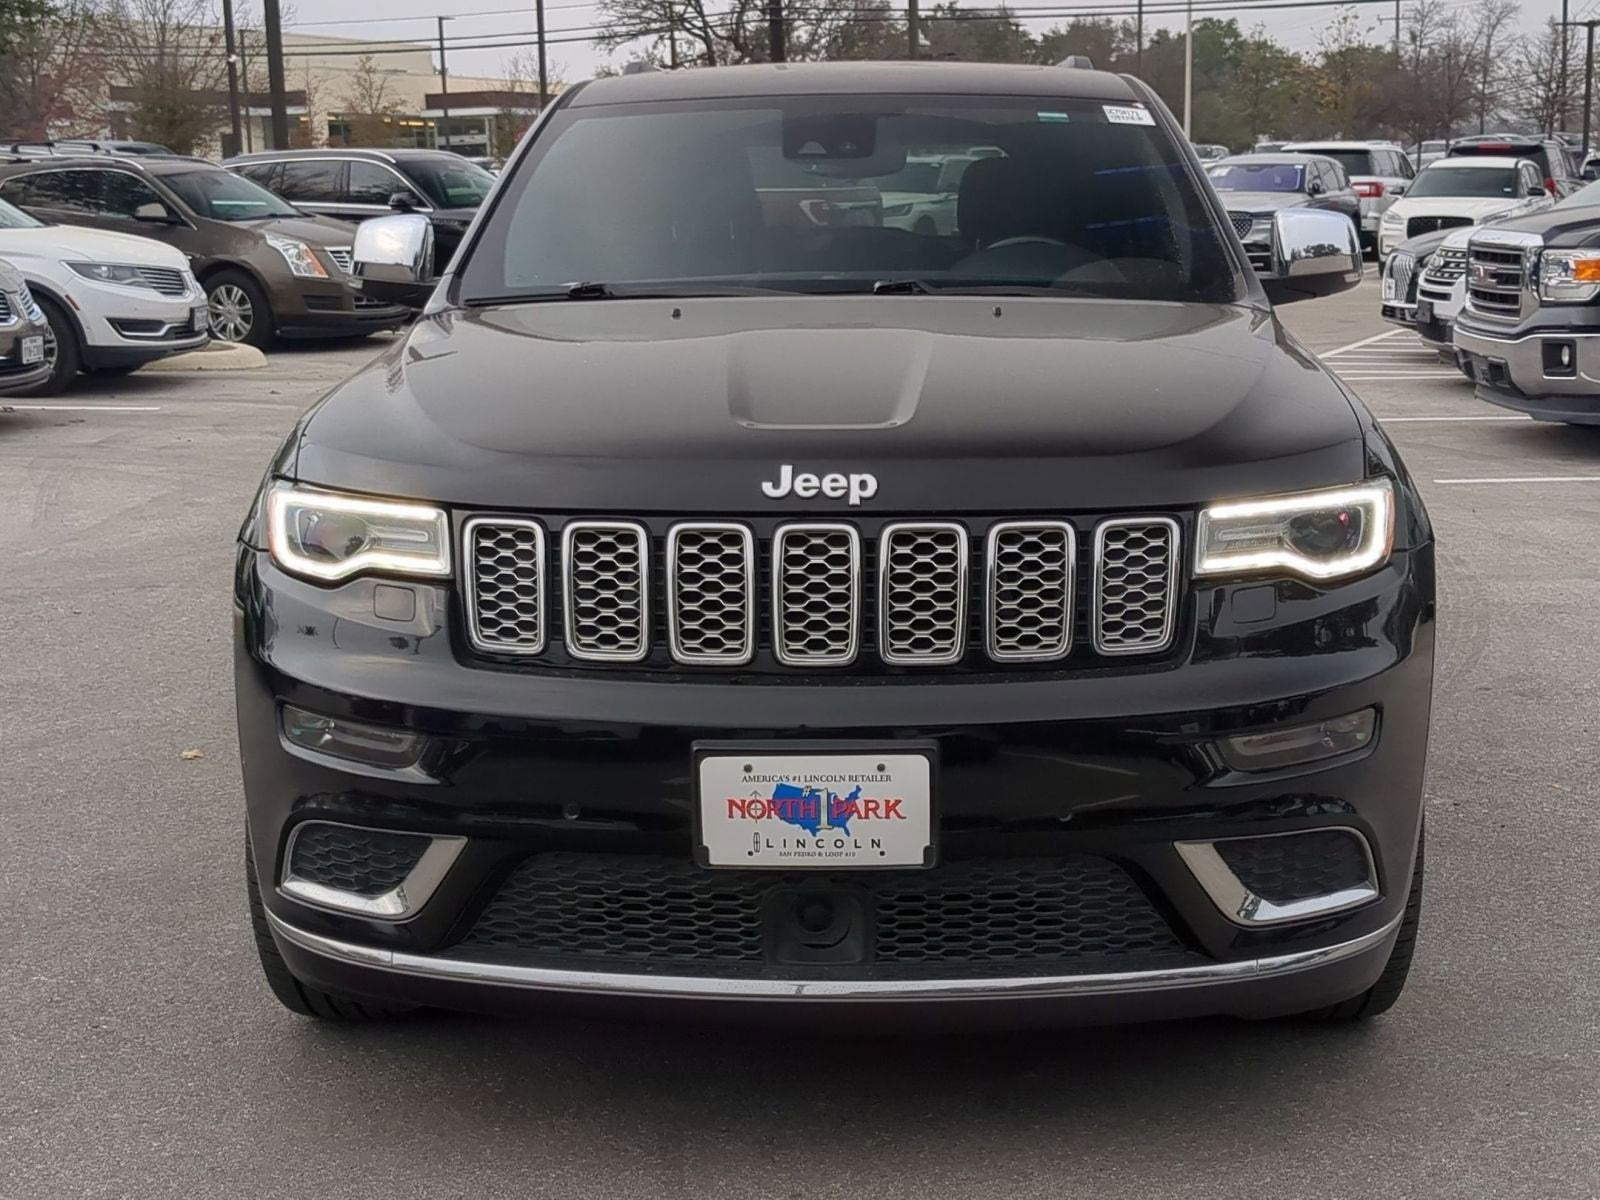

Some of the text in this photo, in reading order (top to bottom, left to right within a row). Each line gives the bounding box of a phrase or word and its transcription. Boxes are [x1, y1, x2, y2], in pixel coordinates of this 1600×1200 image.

[761, 464, 878, 505] Jeep
[741, 773, 892, 783] AMERICA'S #1 LINCOLN RETAILER
[727, 798, 907, 820] NORTH PARK
[765, 838, 881, 849] LINCOLN
